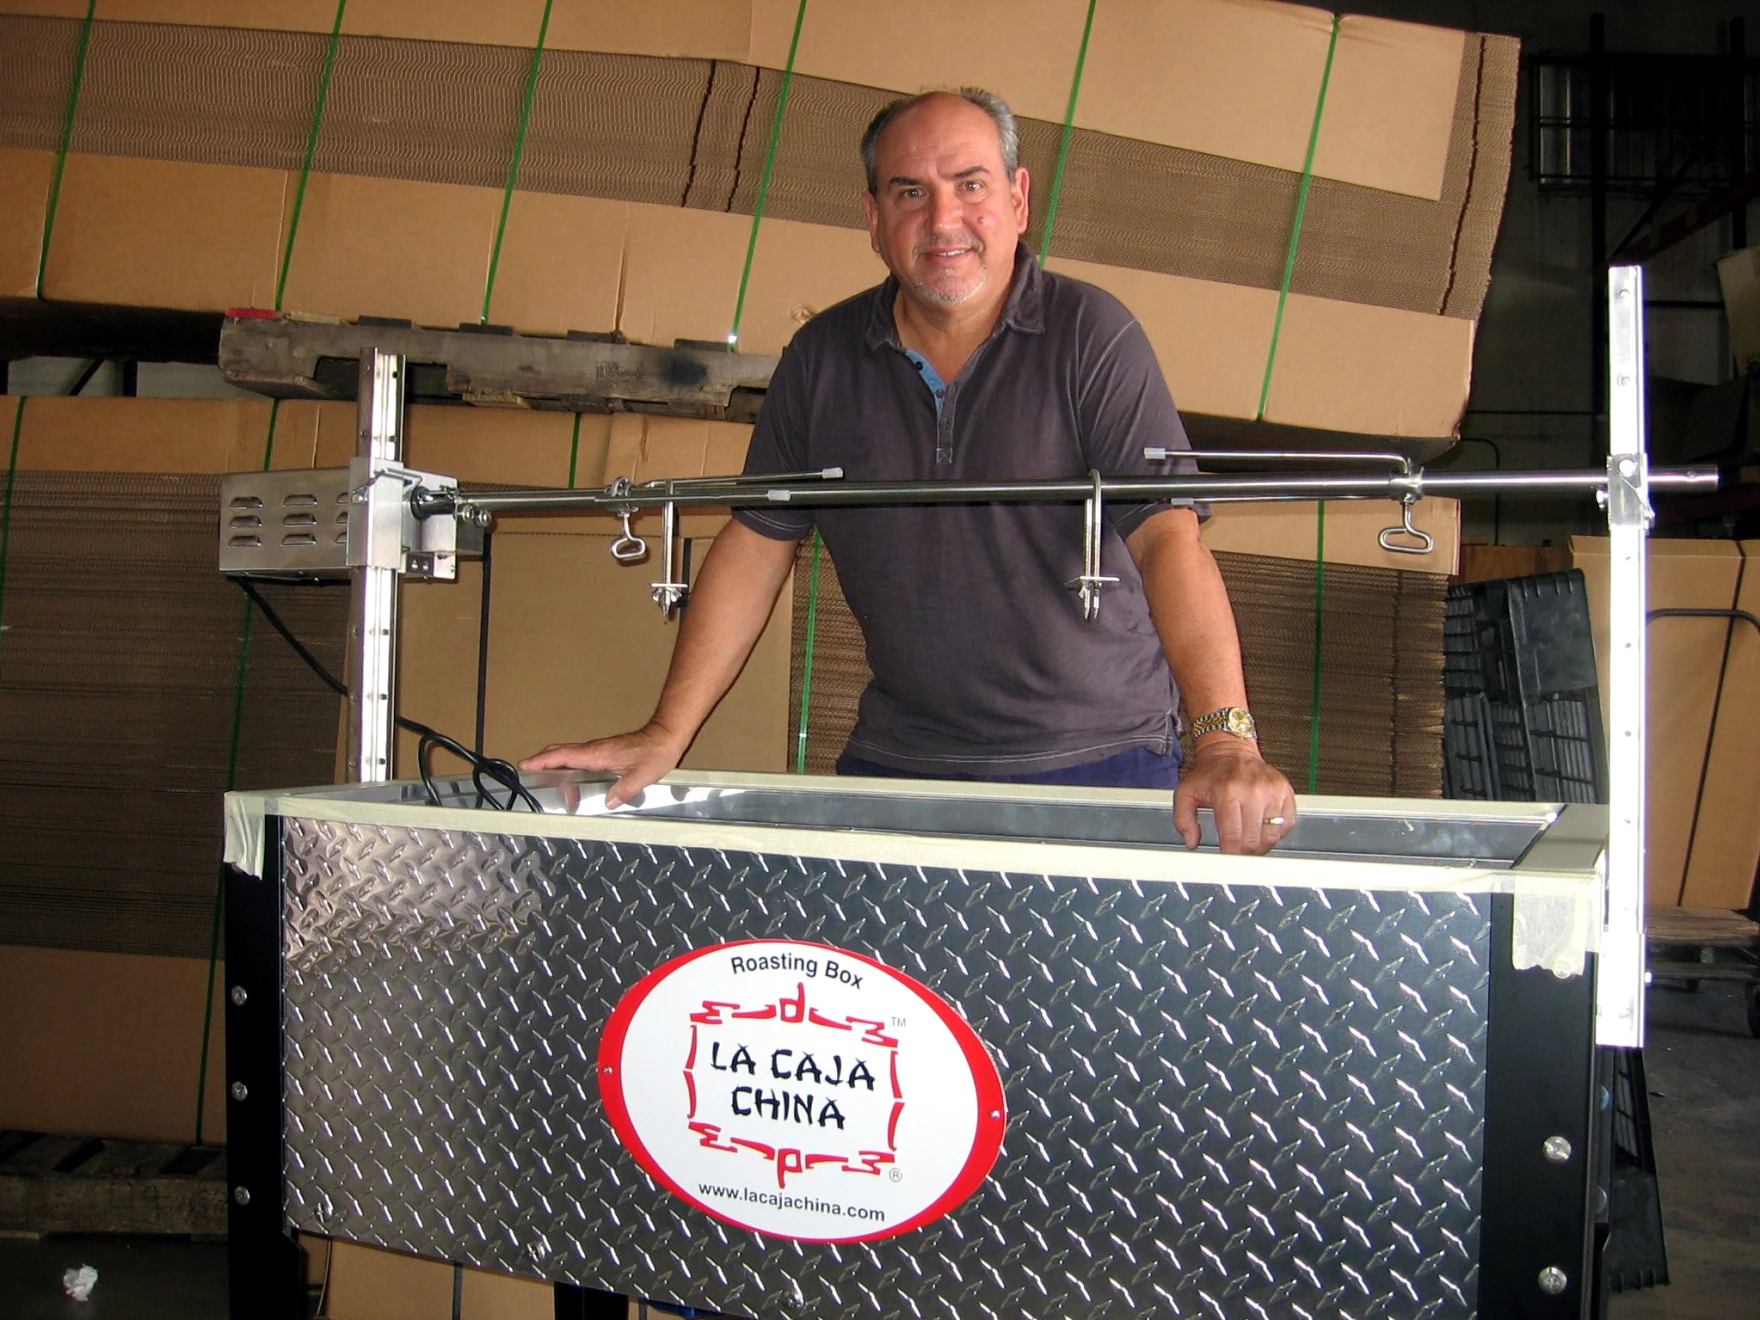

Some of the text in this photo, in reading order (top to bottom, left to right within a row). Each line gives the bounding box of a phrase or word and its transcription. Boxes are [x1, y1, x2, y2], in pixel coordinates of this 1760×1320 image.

[730, 953, 864, 990] Roasting Box
[710, 1041, 876, 1091] LA CAJA
[731, 1085, 846, 1131] CHINA
[698, 1182, 886, 1222] www.lacajachina.com
